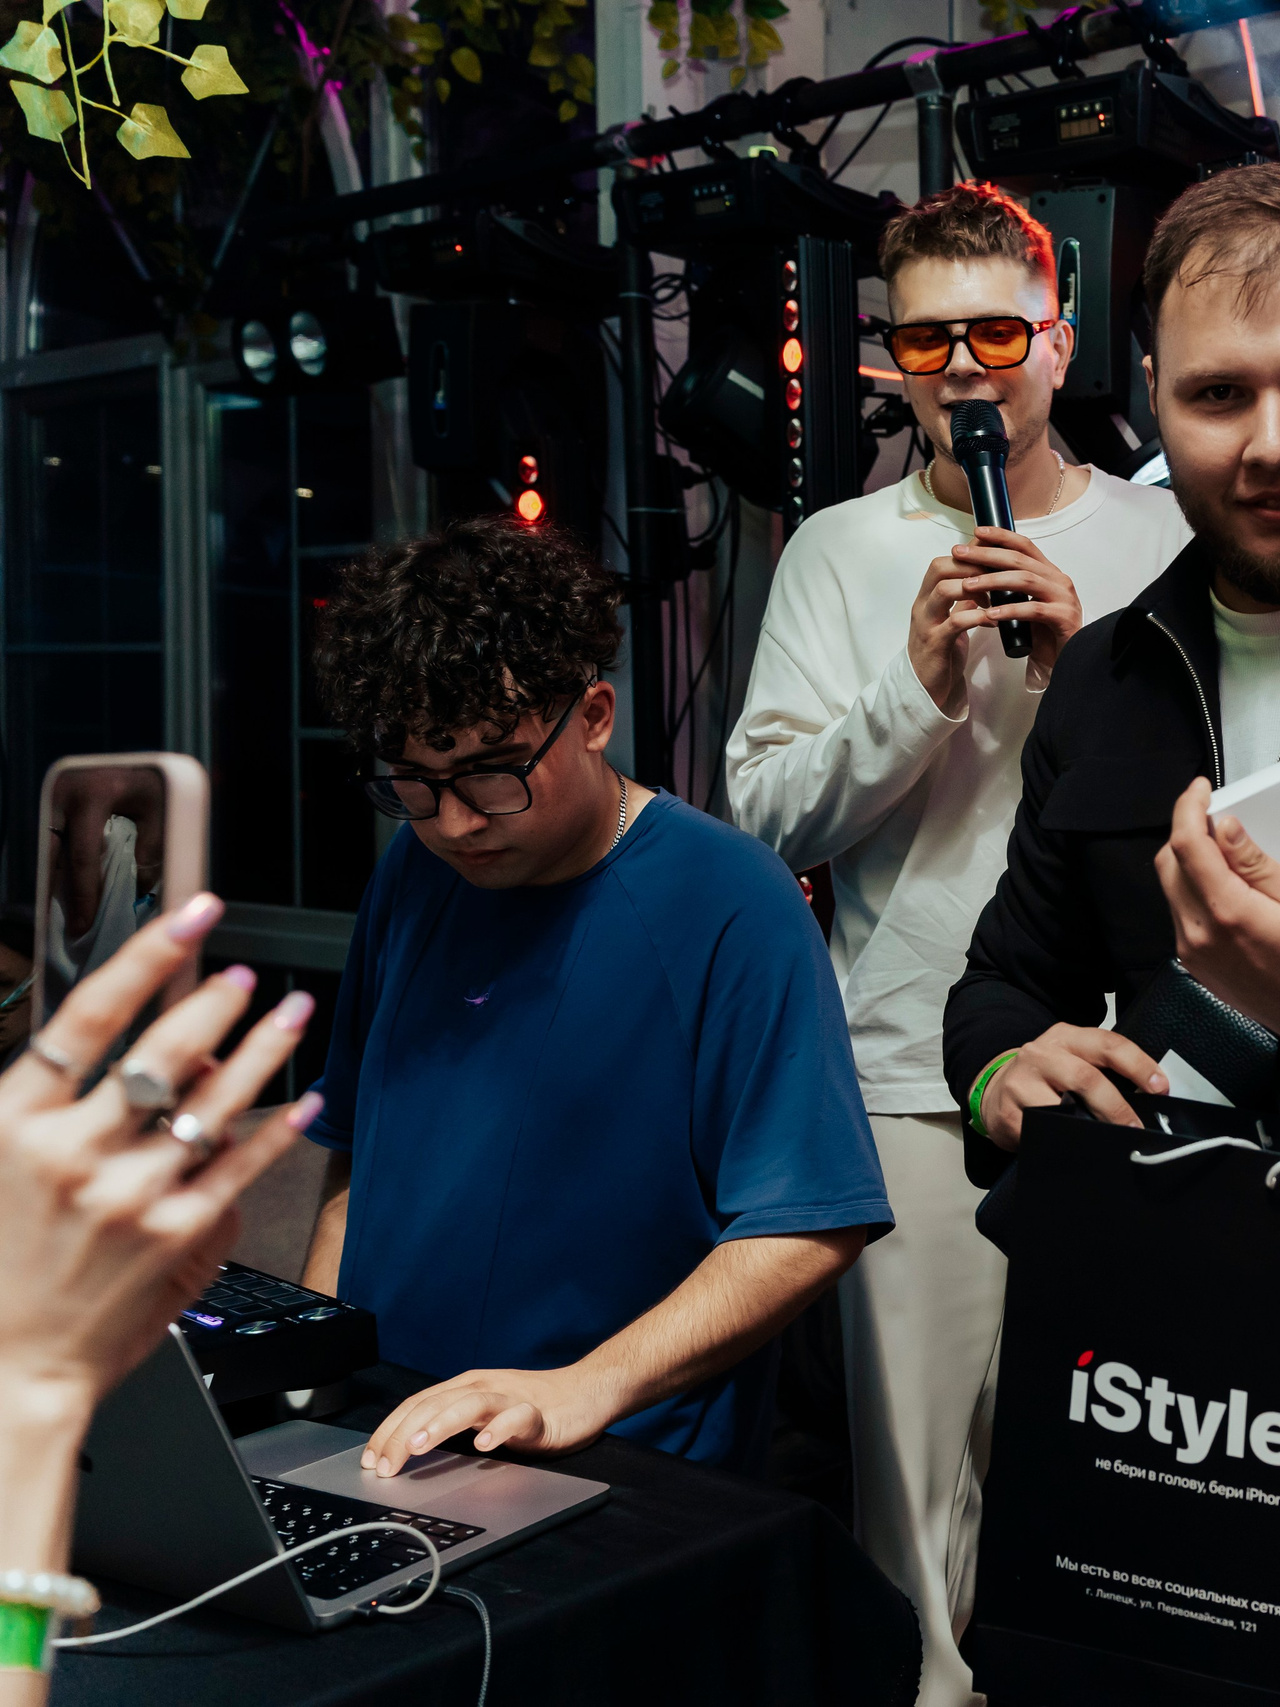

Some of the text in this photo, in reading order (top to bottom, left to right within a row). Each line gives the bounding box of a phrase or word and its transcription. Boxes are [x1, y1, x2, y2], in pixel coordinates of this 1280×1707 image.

[1095, 1458, 1112, 1470] не
[1113, 1459, 1146, 1479] бери
[1148, 1470, 1156, 1481] в
[1158, 1472, 1207, 1494] голову,
[1208, 1480, 1244, 1499] бери
[1056, 1554, 1078, 1572] Мы
[1081, 1562, 1110, 1579] есть
[1113, 1570, 1129, 1583] во
[1131, 1574, 1162, 1590] всех
[1165, 1581, 1249, 1610] социальных
[1086, 1587, 1257, 1633] г. Липецк, ул. Первомайская, 121
